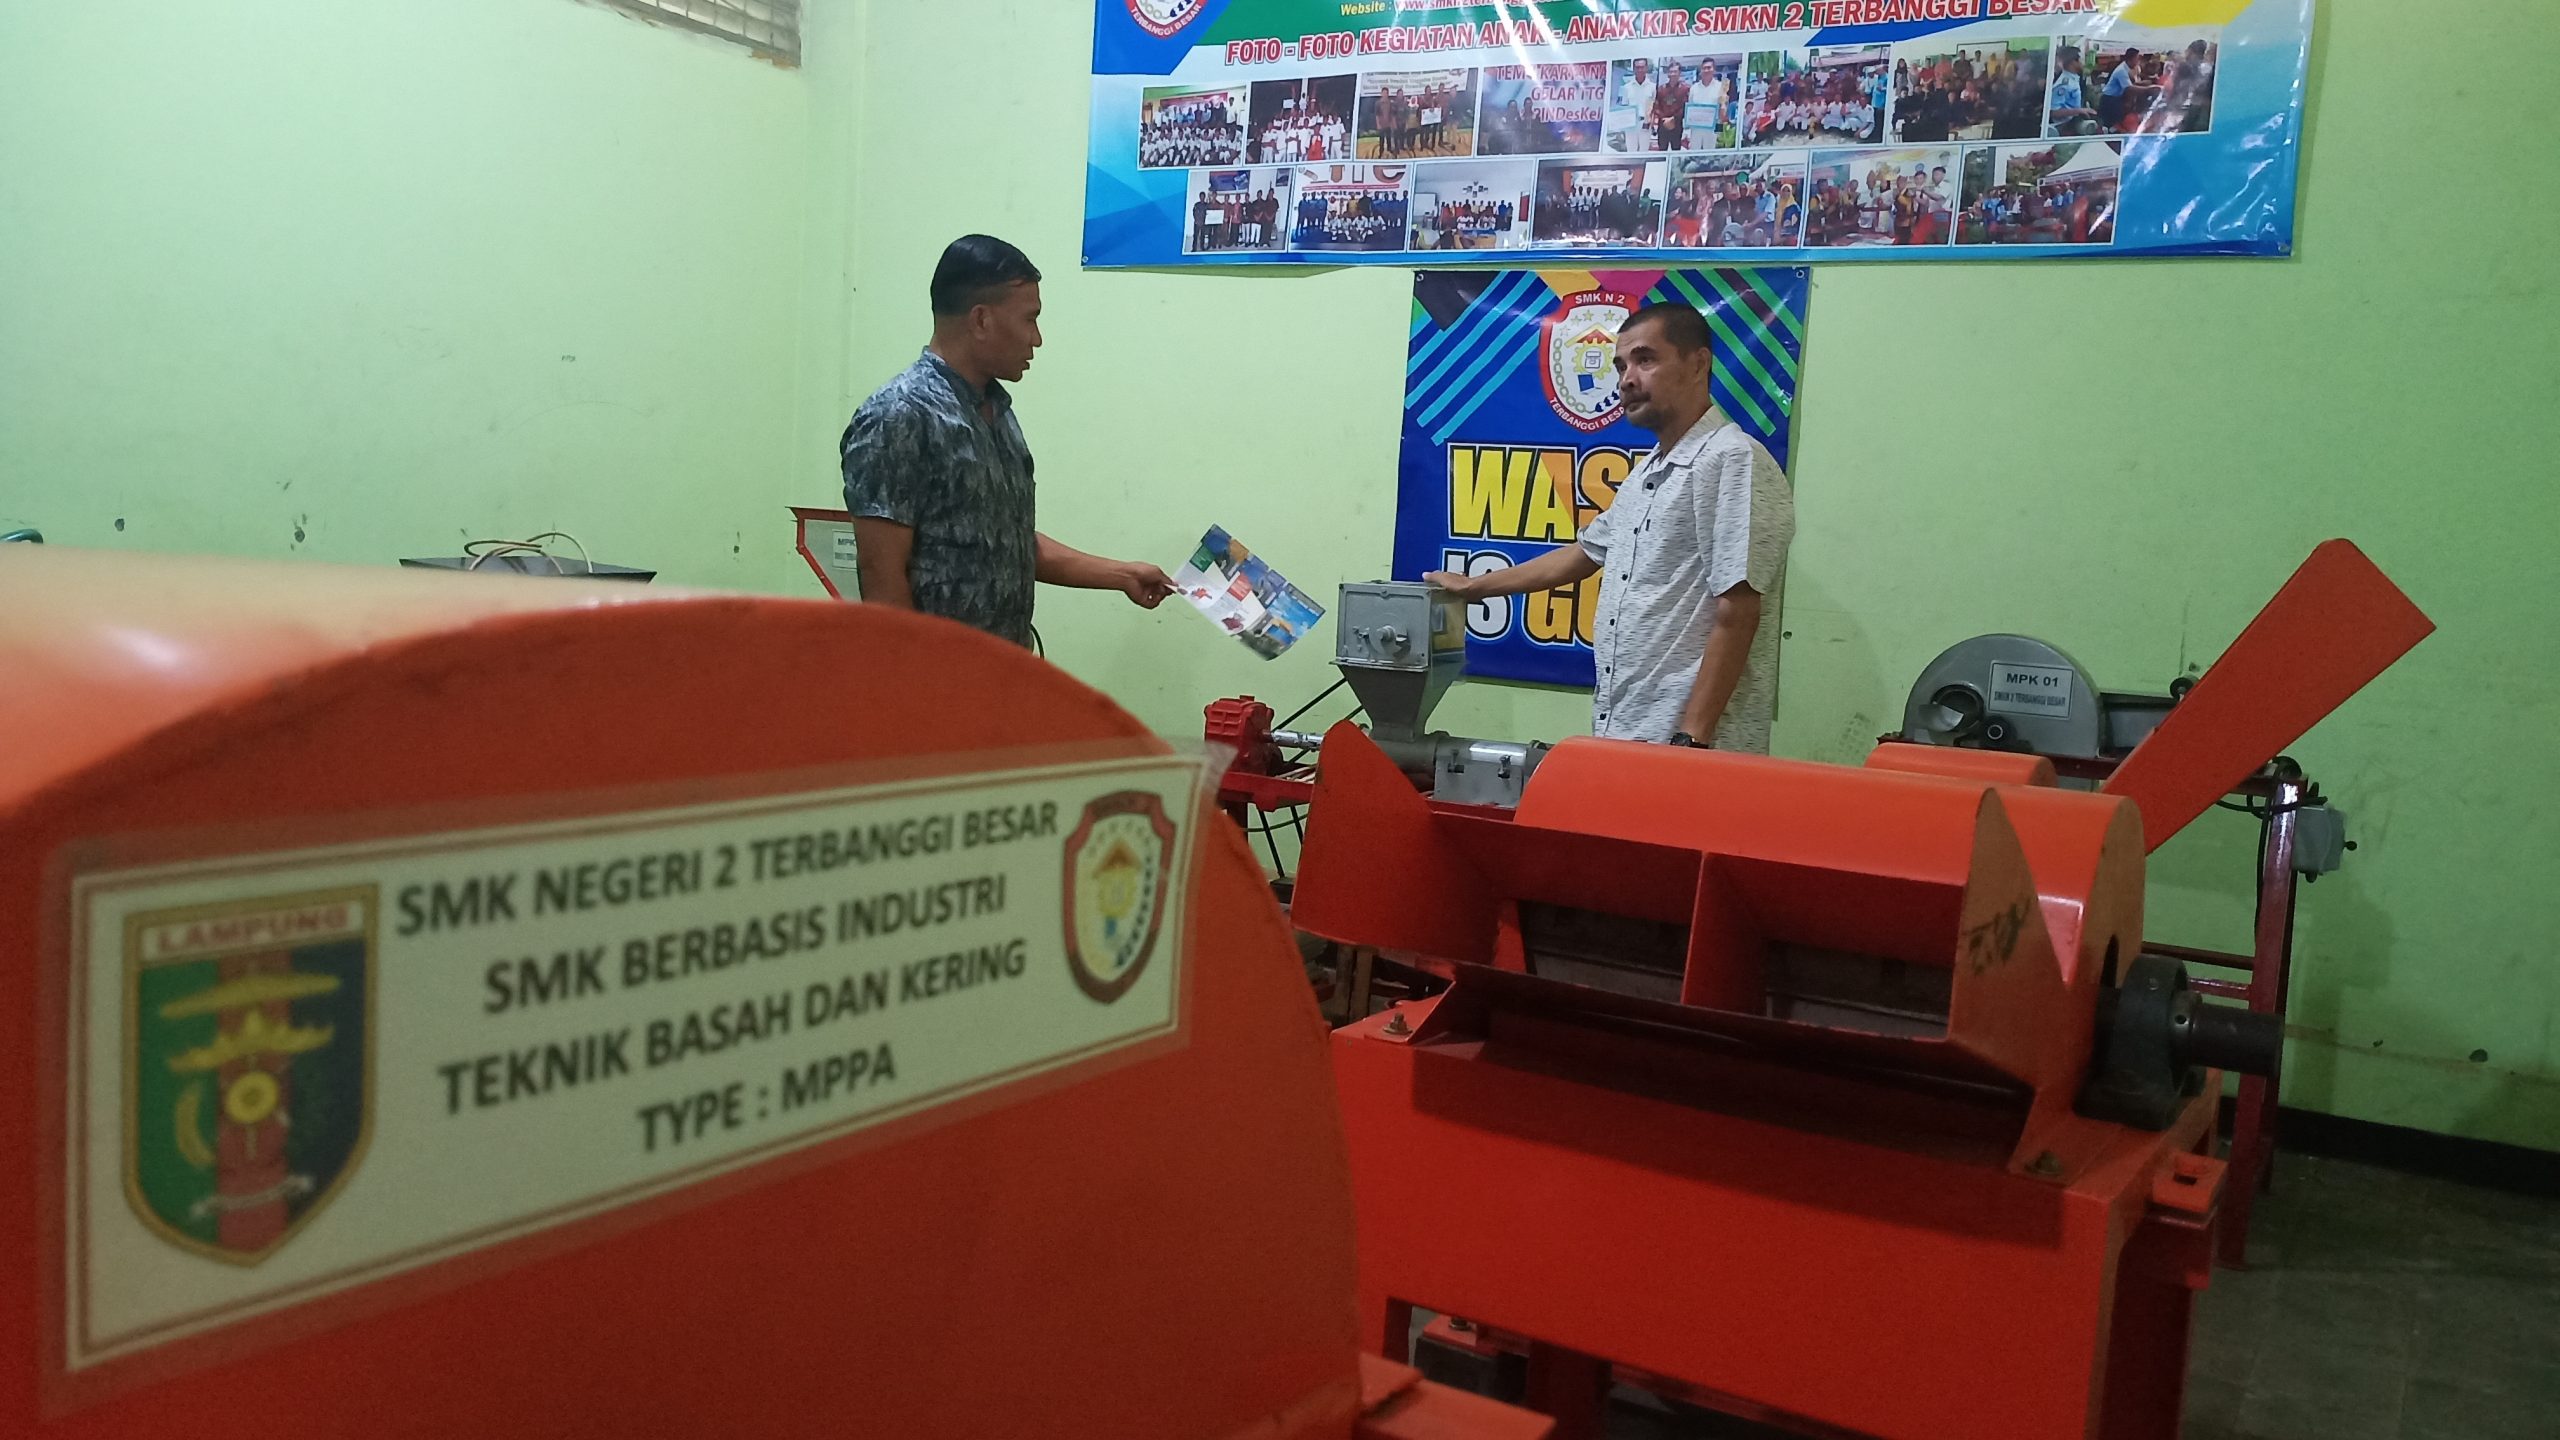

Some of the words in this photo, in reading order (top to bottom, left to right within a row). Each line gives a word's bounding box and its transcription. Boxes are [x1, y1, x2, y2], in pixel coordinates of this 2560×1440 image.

[1130, 6, 1174, 36] TERBANGGI
[1174, 4, 1202, 31] BESAR
[1340, 1, 1386, 16] Website
[1225, 37, 1282, 66] FOTO
[1297, 30, 1355, 61] FOTO
[1357, 20, 1476, 55] KEGIATAN
[1477, 18, 1549, 50] ANAK
[1563, 11, 1640, 45] ANAK
[1640, 9, 1689, 39] KIR
[1692, 4, 1779, 35] SMKN
[1782, 2, 1804, 30] 2
[1809, 0, 1982, 29] TERBANGGI
[1497, 65, 1532, 80] TEM
[1575, 293, 1601, 304] SMK
[1605, 293, 1614, 303] N
[1617, 296, 1626, 304] 2
[1549, 397, 1600, 431] TERBANGGI
[1600, 407, 1626, 425] BESA
[2006, 673, 2039, 686] MPK
[2043, 676, 2059, 687] 01
[396, 872, 519, 938] SMK
[533, 848, 703, 919] NEGERI
[712, 843, 737, 889] 2
[749, 815, 955, 882] TERBANGGI
[962, 800, 1059, 848] BESAR
[157, 907, 349, 951] LAMPUNG
[482, 945, 607, 1015] SMK
[620, 904, 826, 989] BERBASIS
[836, 872, 1007, 944] INDUSTRI
[436, 1026, 632, 1116] TEKNIK
[644, 990, 793, 1069] BASAH
[804, 967, 891, 1028] DAN
[899, 937, 1027, 1003] KERING
[637, 1080, 745, 1152] TYPE
[781, 1041, 896, 1112] MPPA
